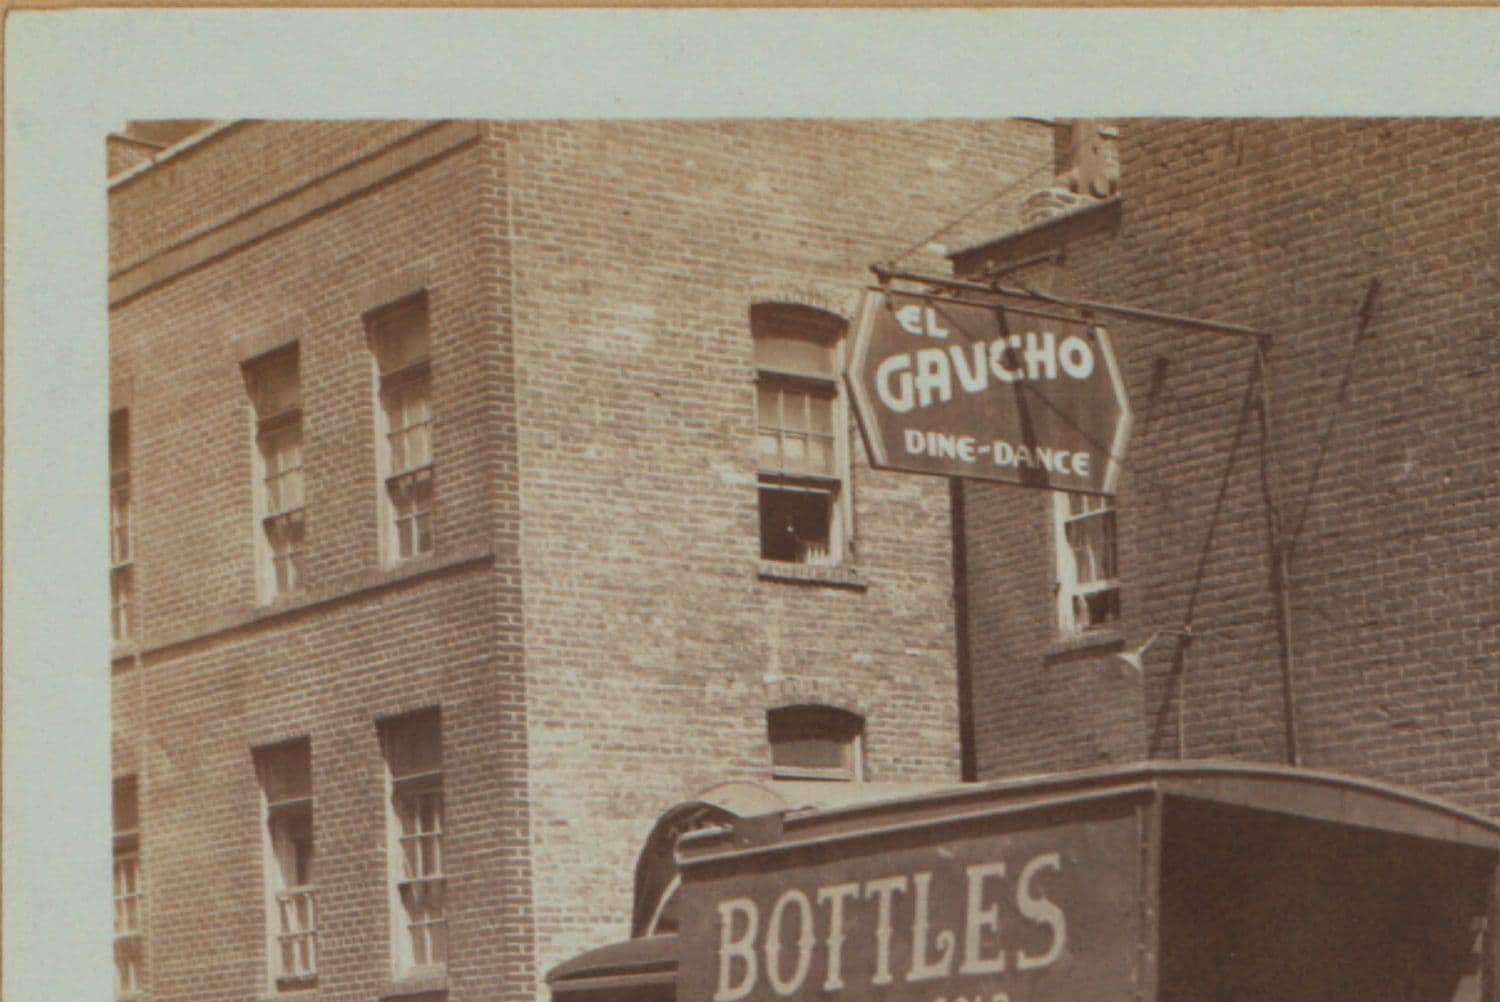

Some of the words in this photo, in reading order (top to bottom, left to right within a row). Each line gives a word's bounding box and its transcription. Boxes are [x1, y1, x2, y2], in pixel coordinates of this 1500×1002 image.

[896, 305, 948, 339] EL
[876, 332, 1095, 413] GAUCHO
[904, 430, 1090, 477] DINE-DANCE
